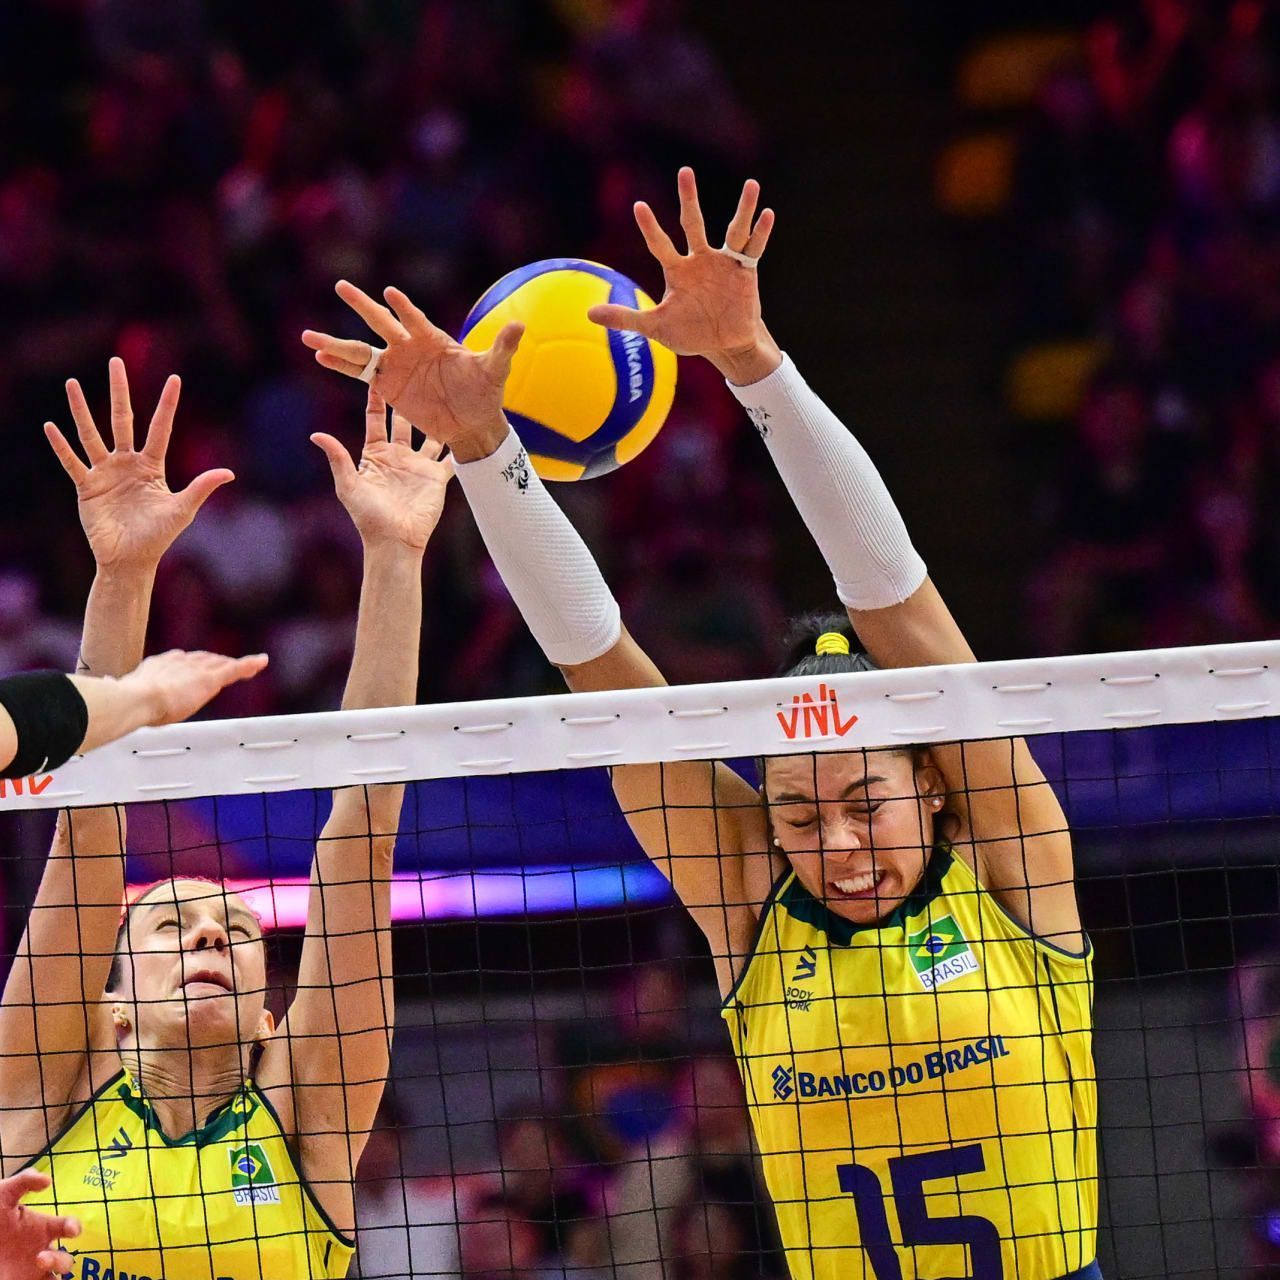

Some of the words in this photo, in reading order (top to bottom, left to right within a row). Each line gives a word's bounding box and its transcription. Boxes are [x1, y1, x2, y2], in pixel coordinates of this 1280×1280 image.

[776, 683, 859, 739] VNL
[920, 953, 978, 990] BRASIL
[797, 1069, 886, 1098] BANCO
[888, 1061, 924, 1088] DO
[924, 1034, 1010, 1080] BRASIL
[81, 1175, 117, 1191] WORK
[88, 1164, 121, 1179] BODY
[234, 1185, 280, 1203] BRASIL
